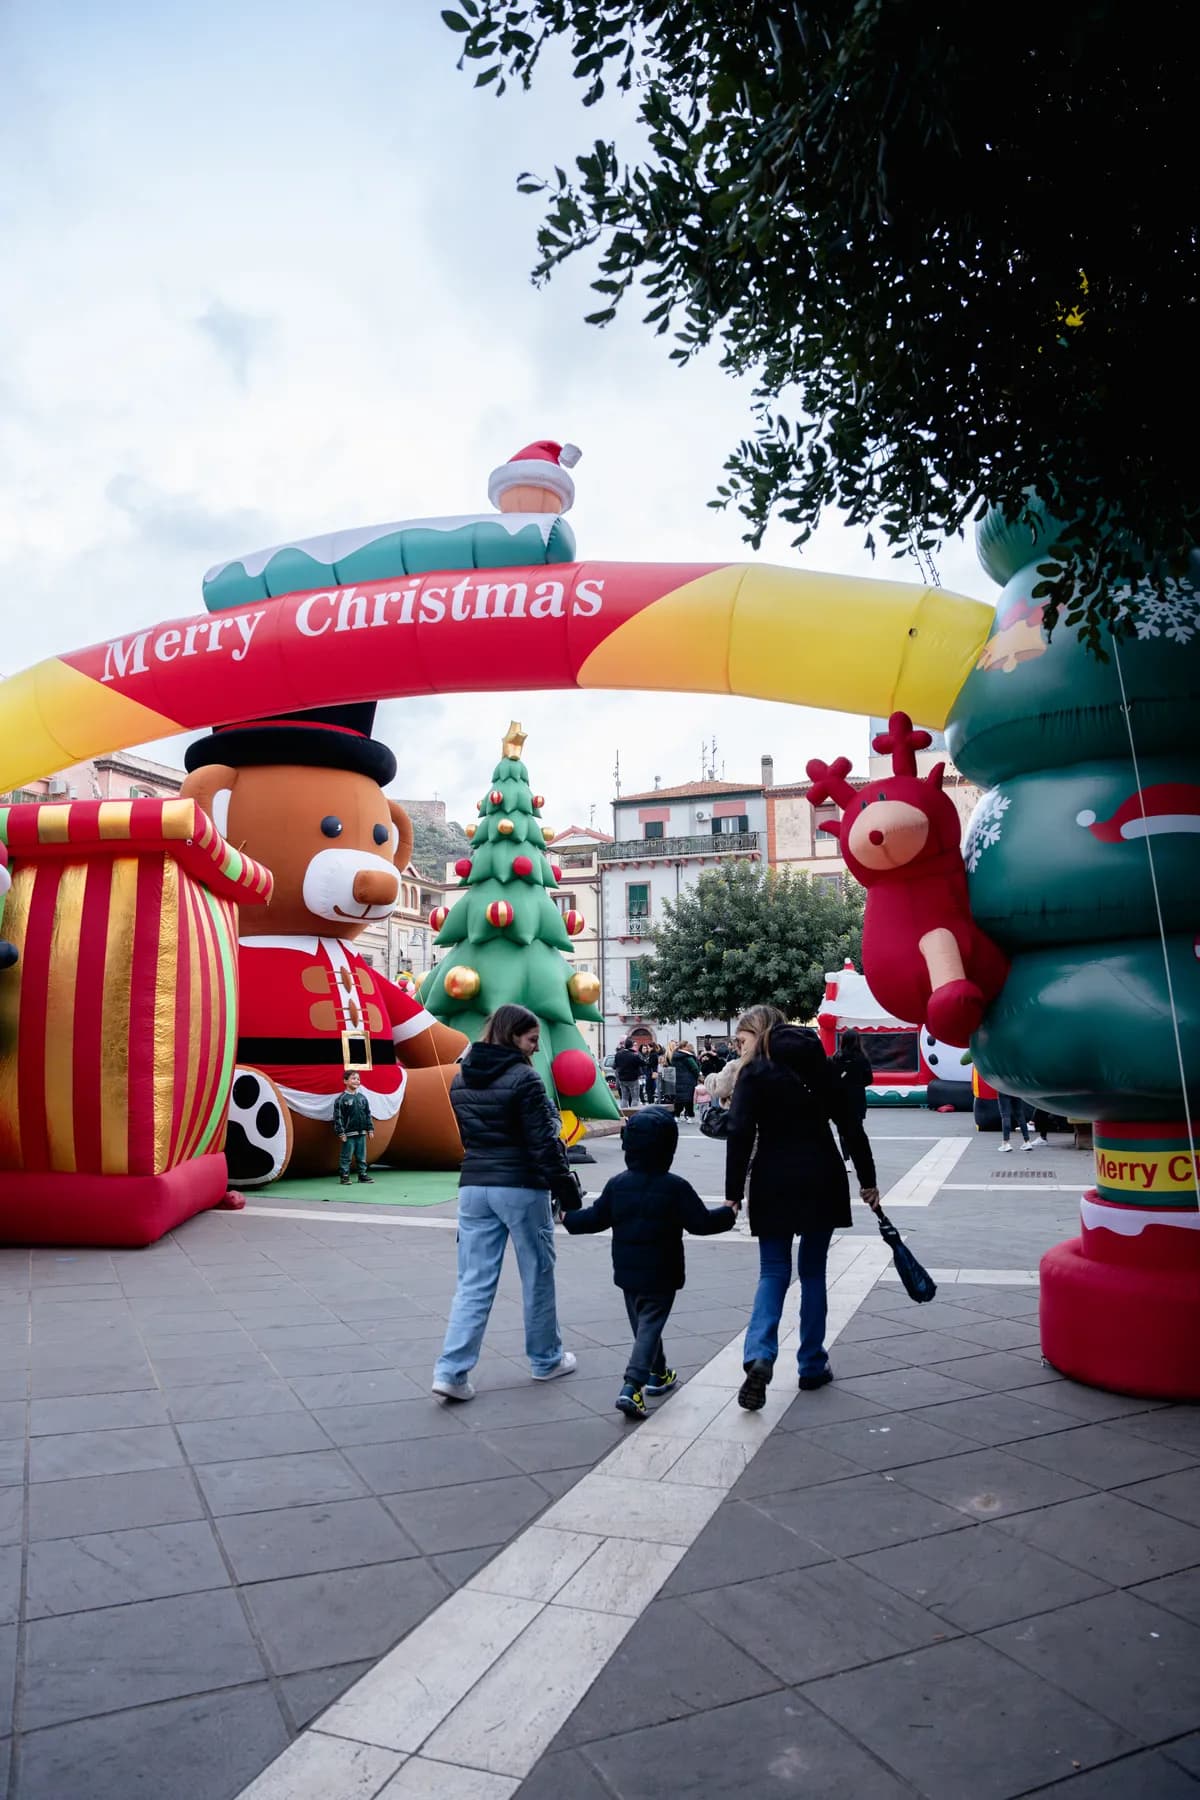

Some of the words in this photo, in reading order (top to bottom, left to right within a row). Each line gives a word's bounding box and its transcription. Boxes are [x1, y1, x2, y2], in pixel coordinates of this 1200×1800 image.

[100, 610, 267, 682] Merry
[295, 576, 605, 637] Christmas
[1096, 1152, 1158, 1189] Merry
